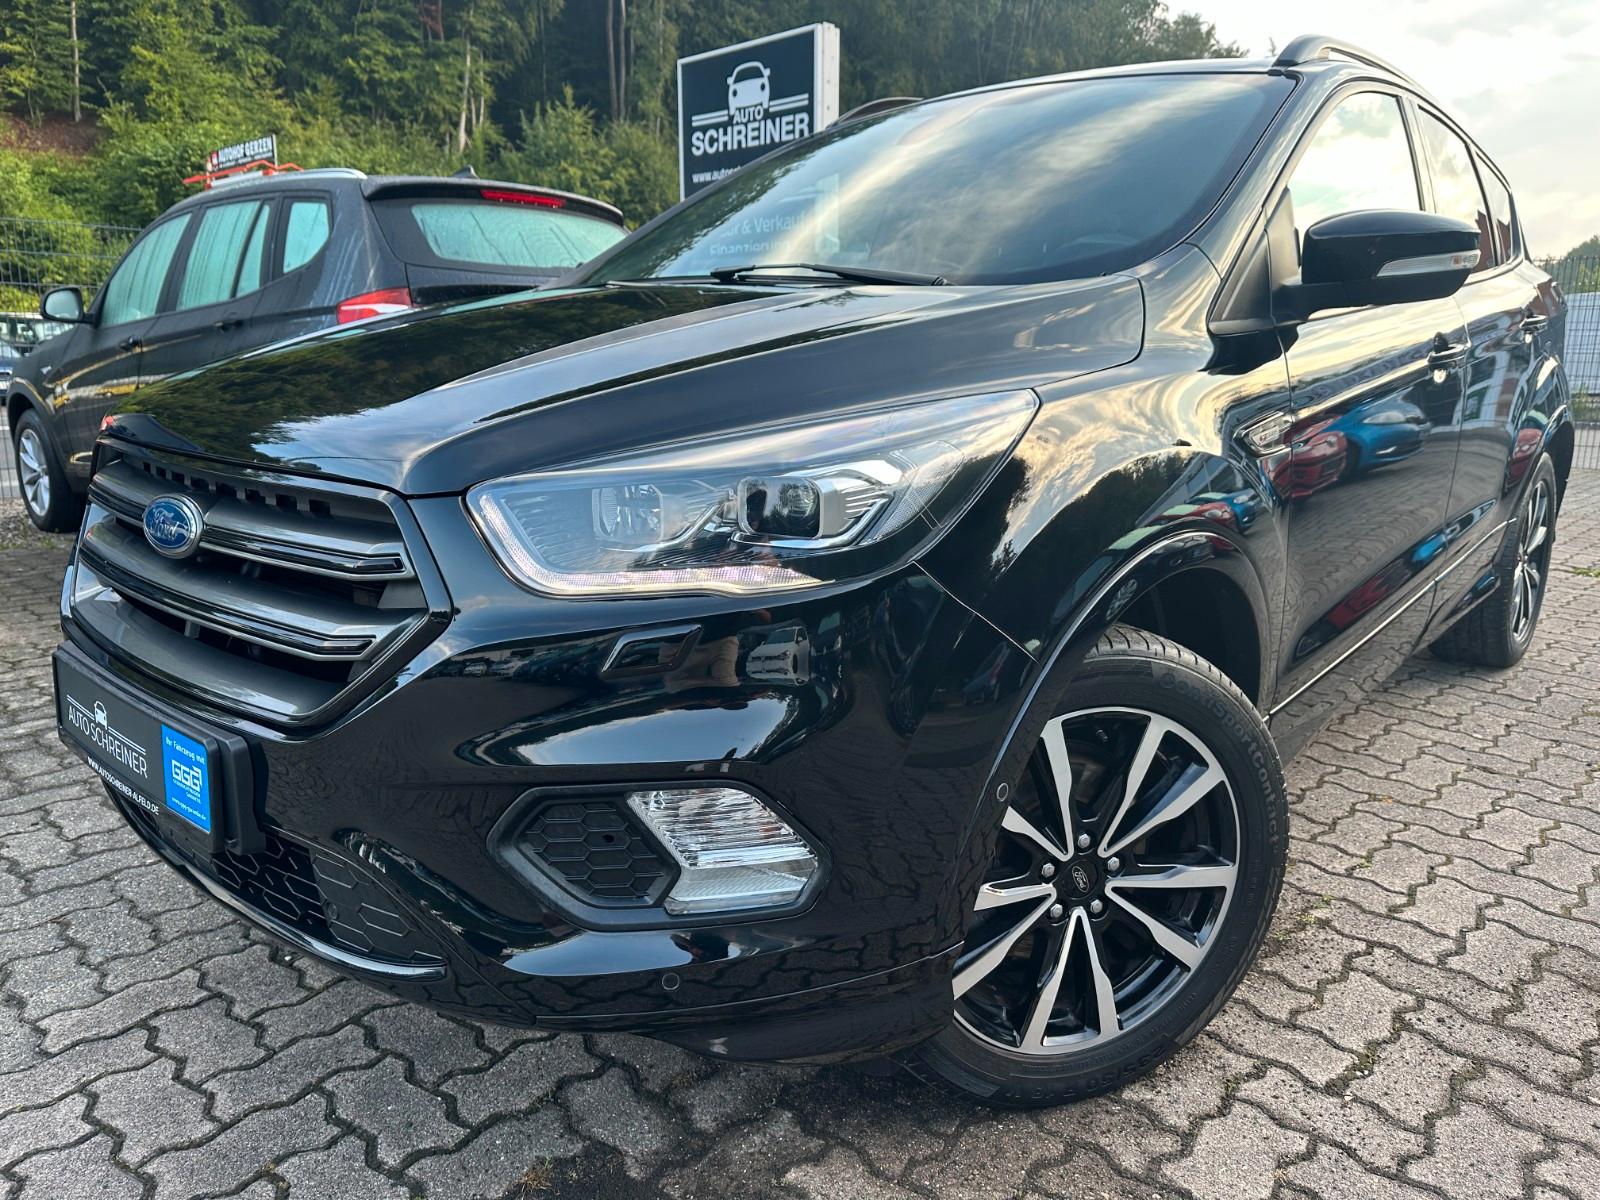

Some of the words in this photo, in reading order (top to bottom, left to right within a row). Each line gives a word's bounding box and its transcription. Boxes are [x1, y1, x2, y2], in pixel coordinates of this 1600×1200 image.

[733, 105, 764, 124] AUTO
[692, 112, 809, 156] SCHREINER
[742, 219, 753, 234] &
[149, 508, 185, 541] Ford
[68, 705, 90, 736] AUTO
[90, 722, 148, 779] SCHREINER
[172, 759, 202, 793] GGG
